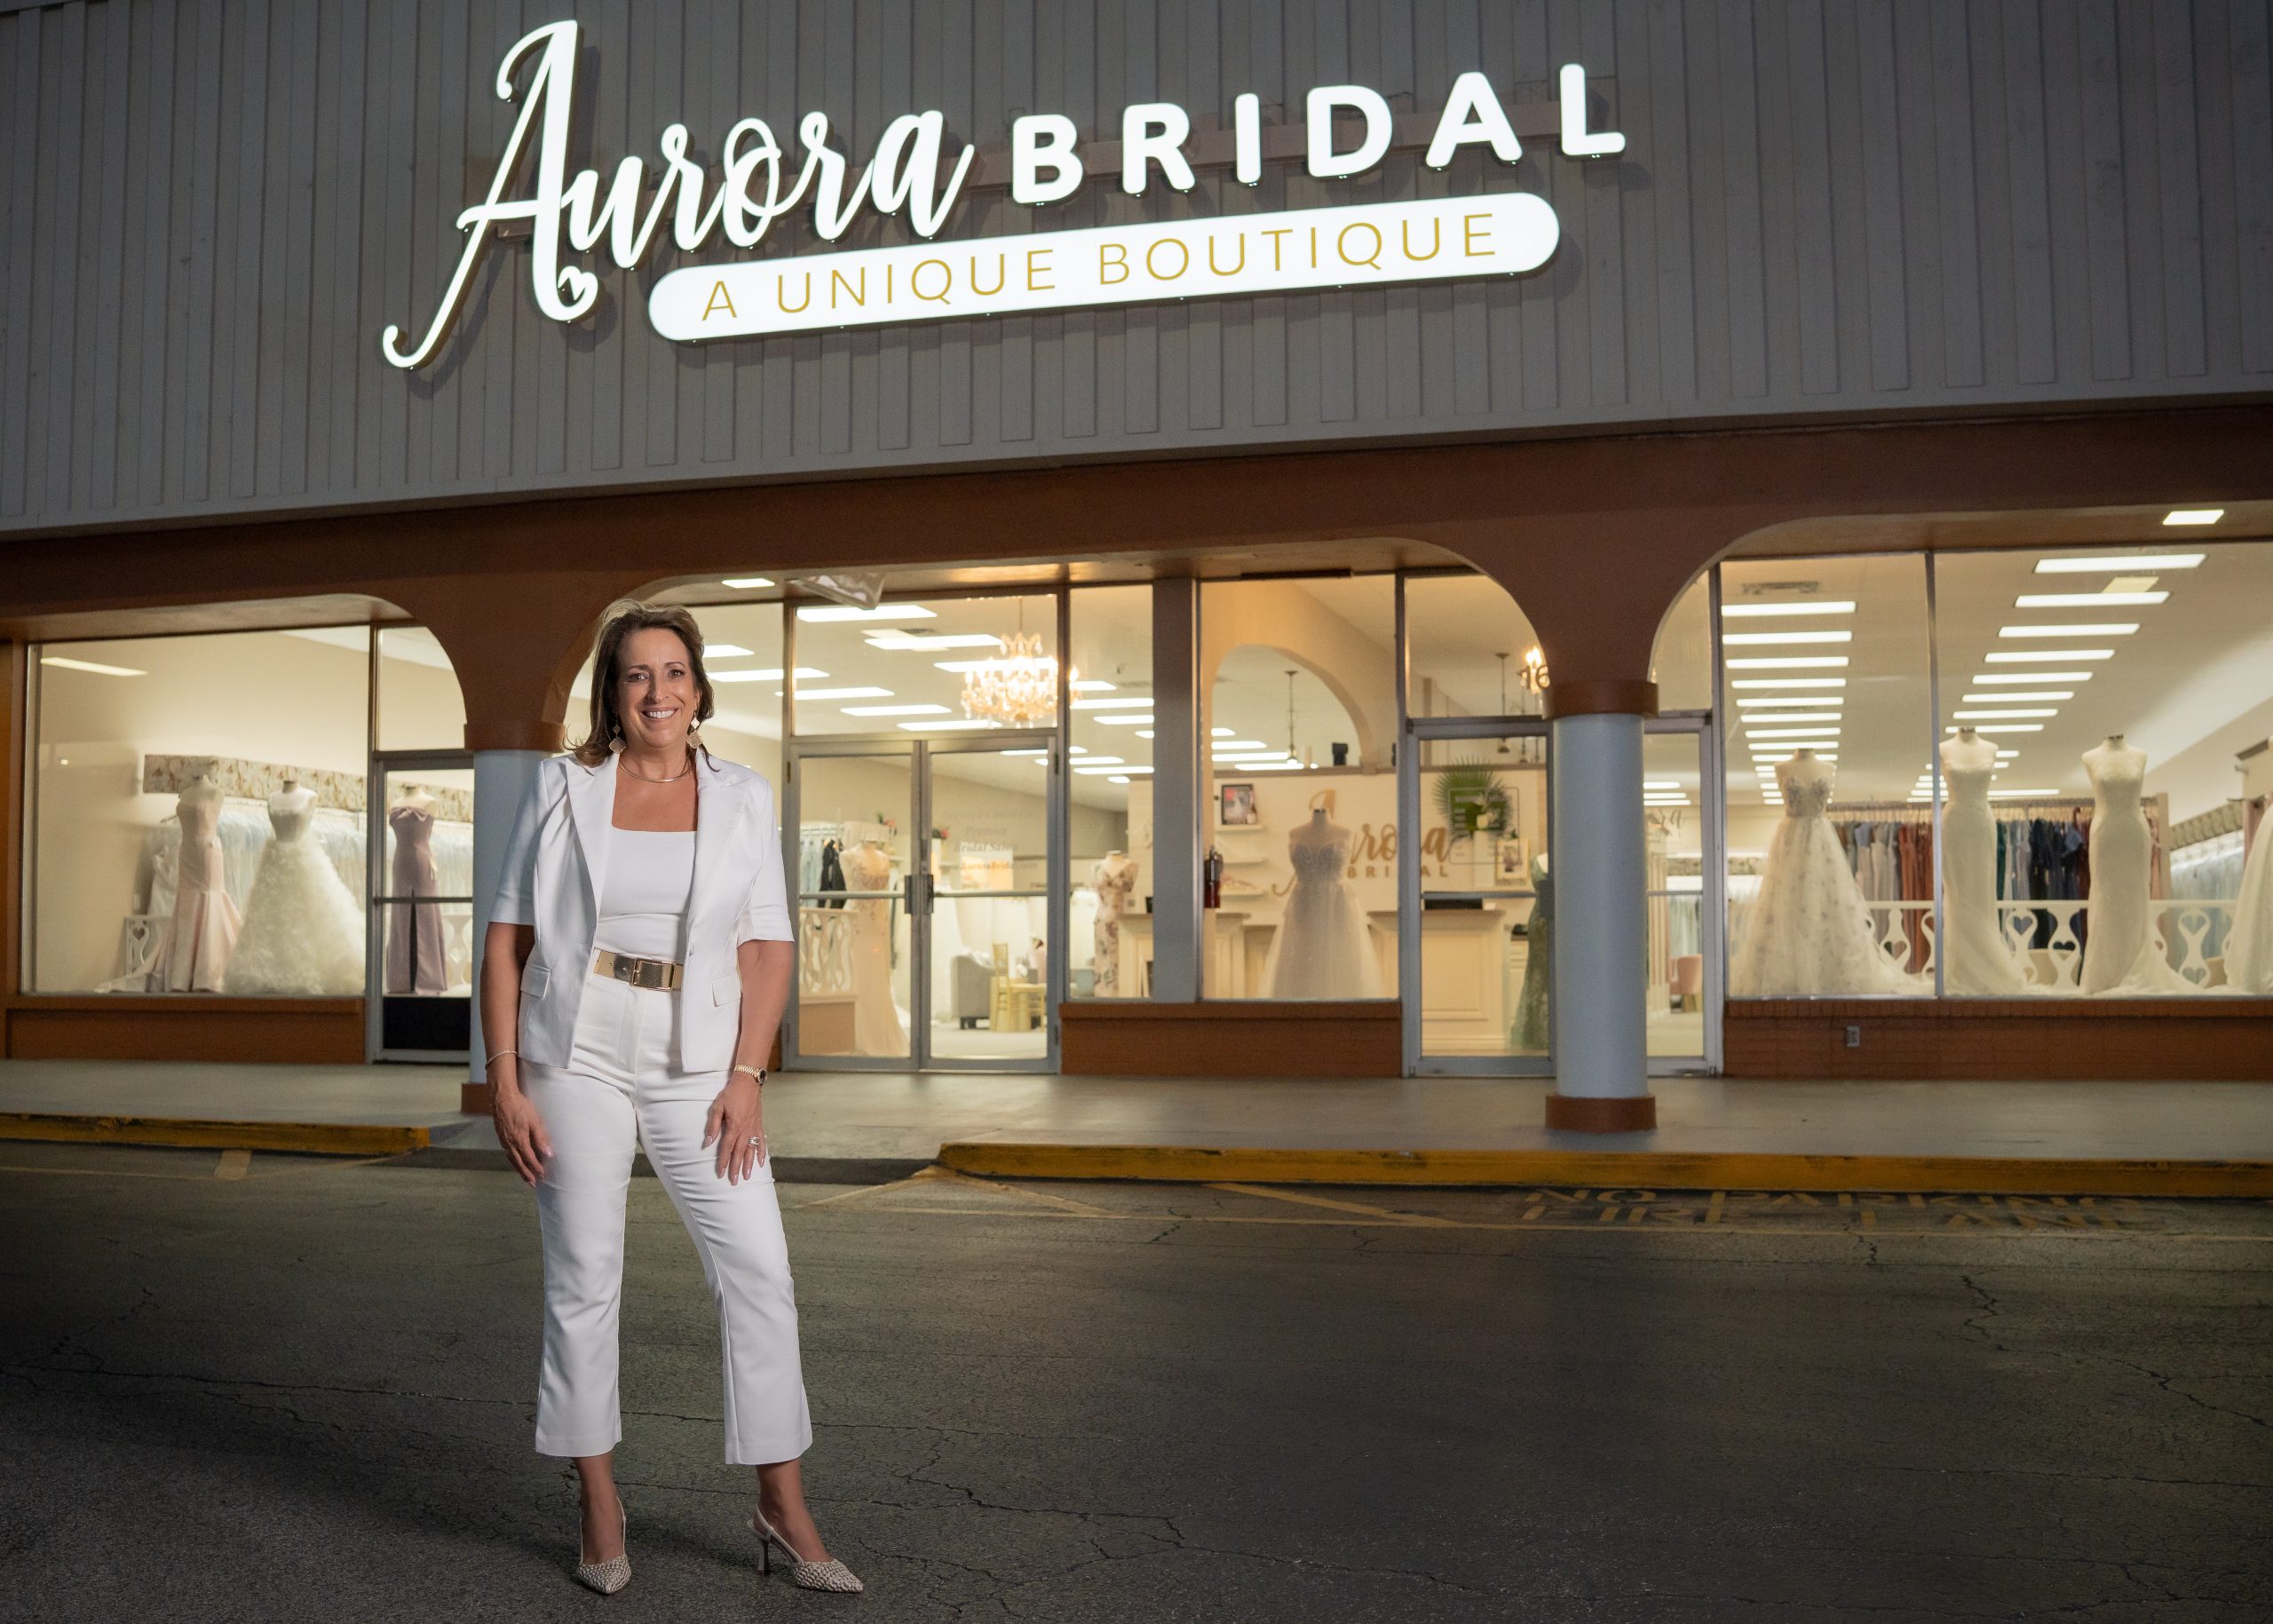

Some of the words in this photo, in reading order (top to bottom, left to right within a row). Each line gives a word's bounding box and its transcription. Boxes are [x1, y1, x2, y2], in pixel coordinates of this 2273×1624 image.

[383, 20, 974, 368] Aurora
[1012, 63, 1626, 204] BRIDAL
[701, 280, 739, 321] A
[777, 249, 1056, 313] UNIQUE
[1097, 212, 1496, 284] BOUTIQUE
[1346, 865, 1448, 879] BRIAL
[1524, 1189, 1657, 1203] NO
